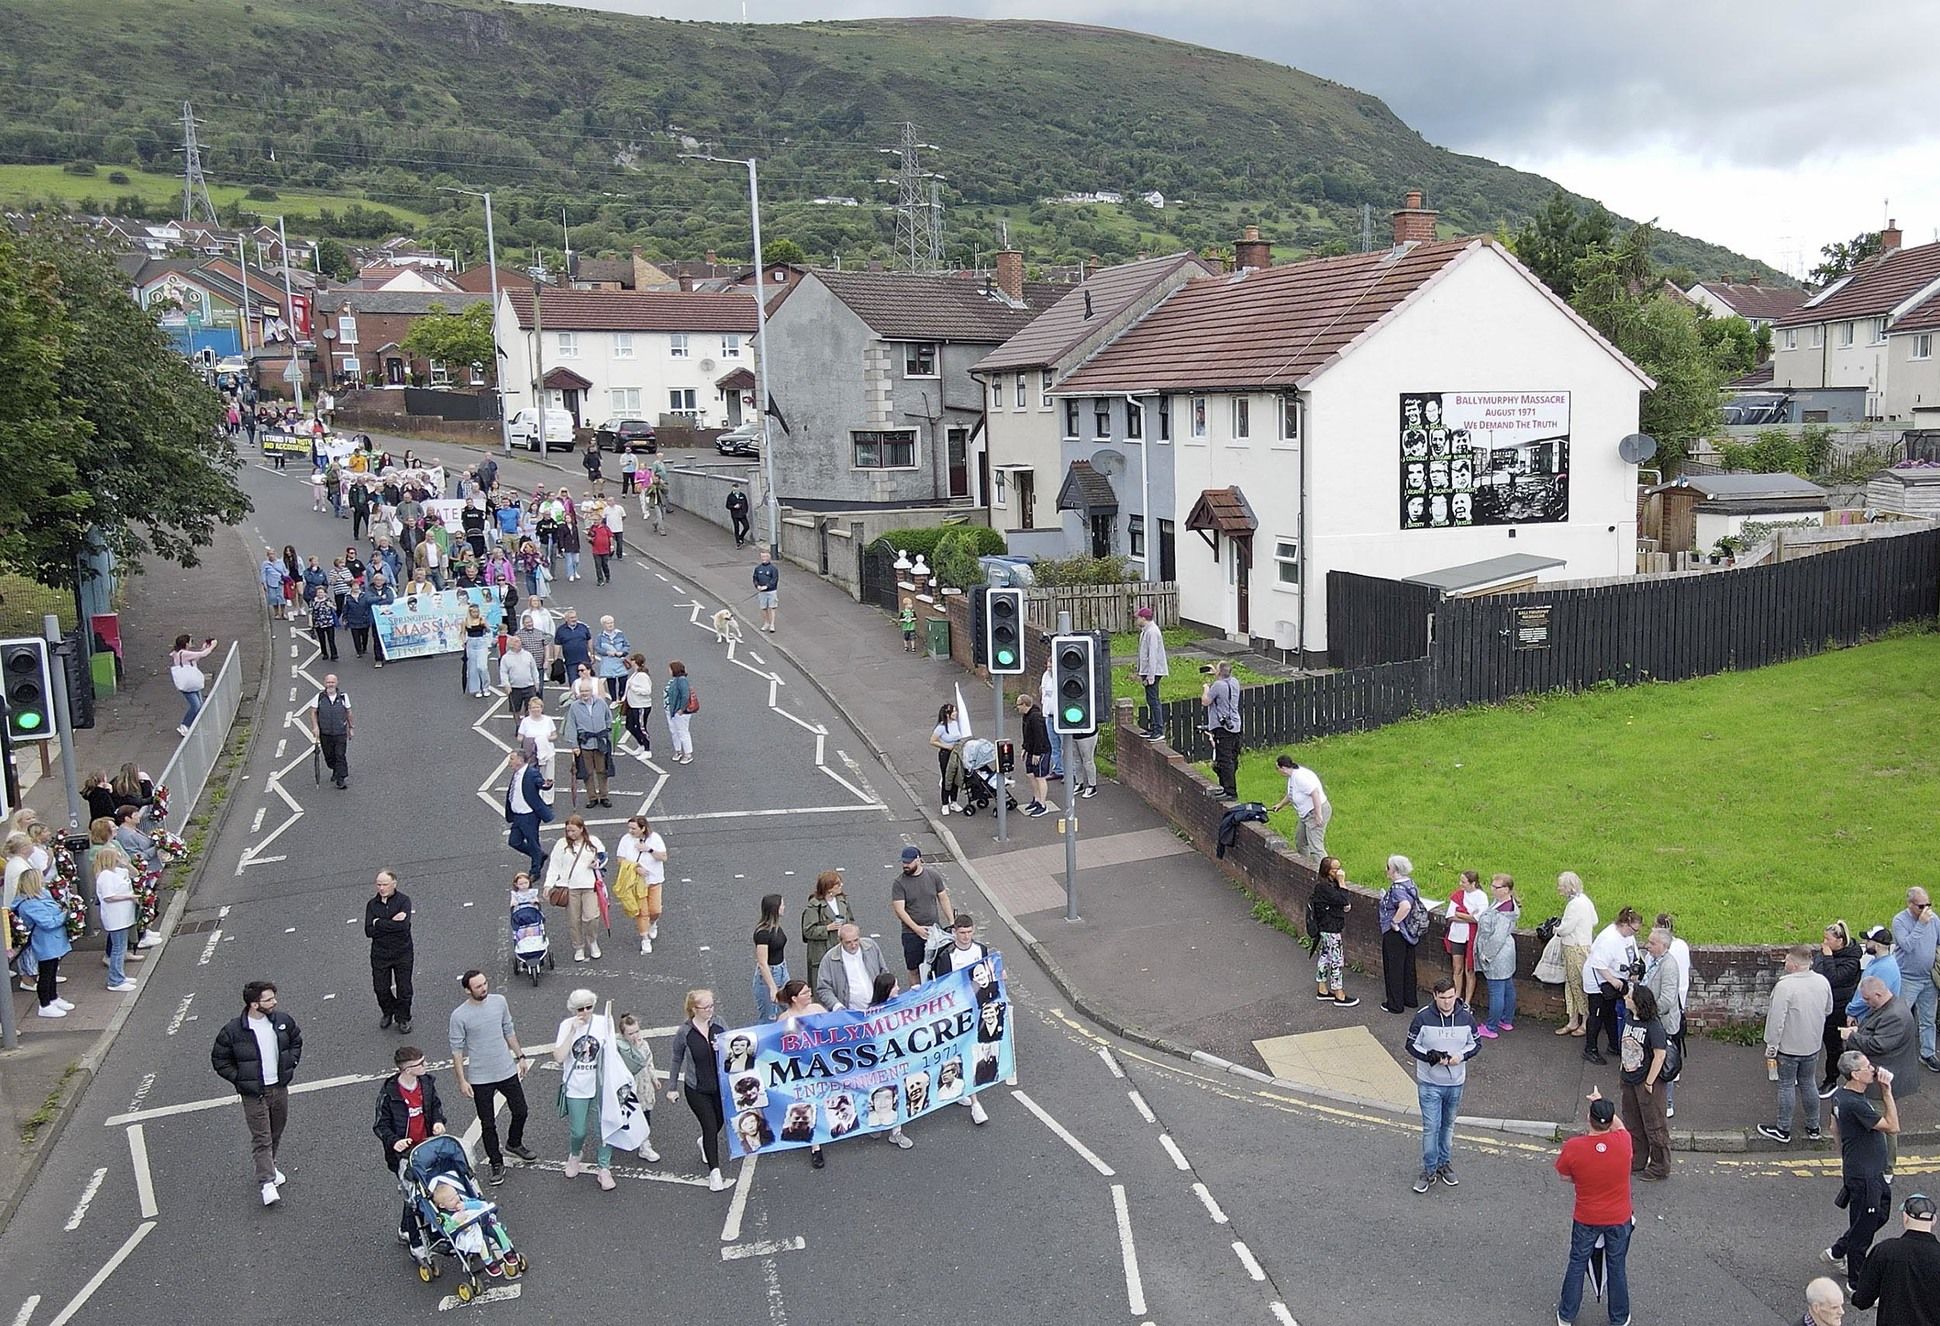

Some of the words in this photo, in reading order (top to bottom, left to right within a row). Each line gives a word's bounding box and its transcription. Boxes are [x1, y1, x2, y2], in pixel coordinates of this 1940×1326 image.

[1455, 395, 1519, 405] BALLYMURPHY
[1520, 395, 1566, 404] MASSACRE
[1485, 408, 1516, 417] AUGUST
[1518, 408, 1536, 416] 1971
[1463, 421, 1478, 430] WE
[1479, 420, 1515, 430] DEMAND
[1516, 420, 1531, 429] THE
[1532, 419, 1558, 429] TRUTH
[780, 991, 957, 1053] BALLYMURPHY
[768, 1008, 975, 1088] MASSACRE
[794, 1062, 910, 1101] INTERNMENT
[921, 1043, 960, 1069] 1971
